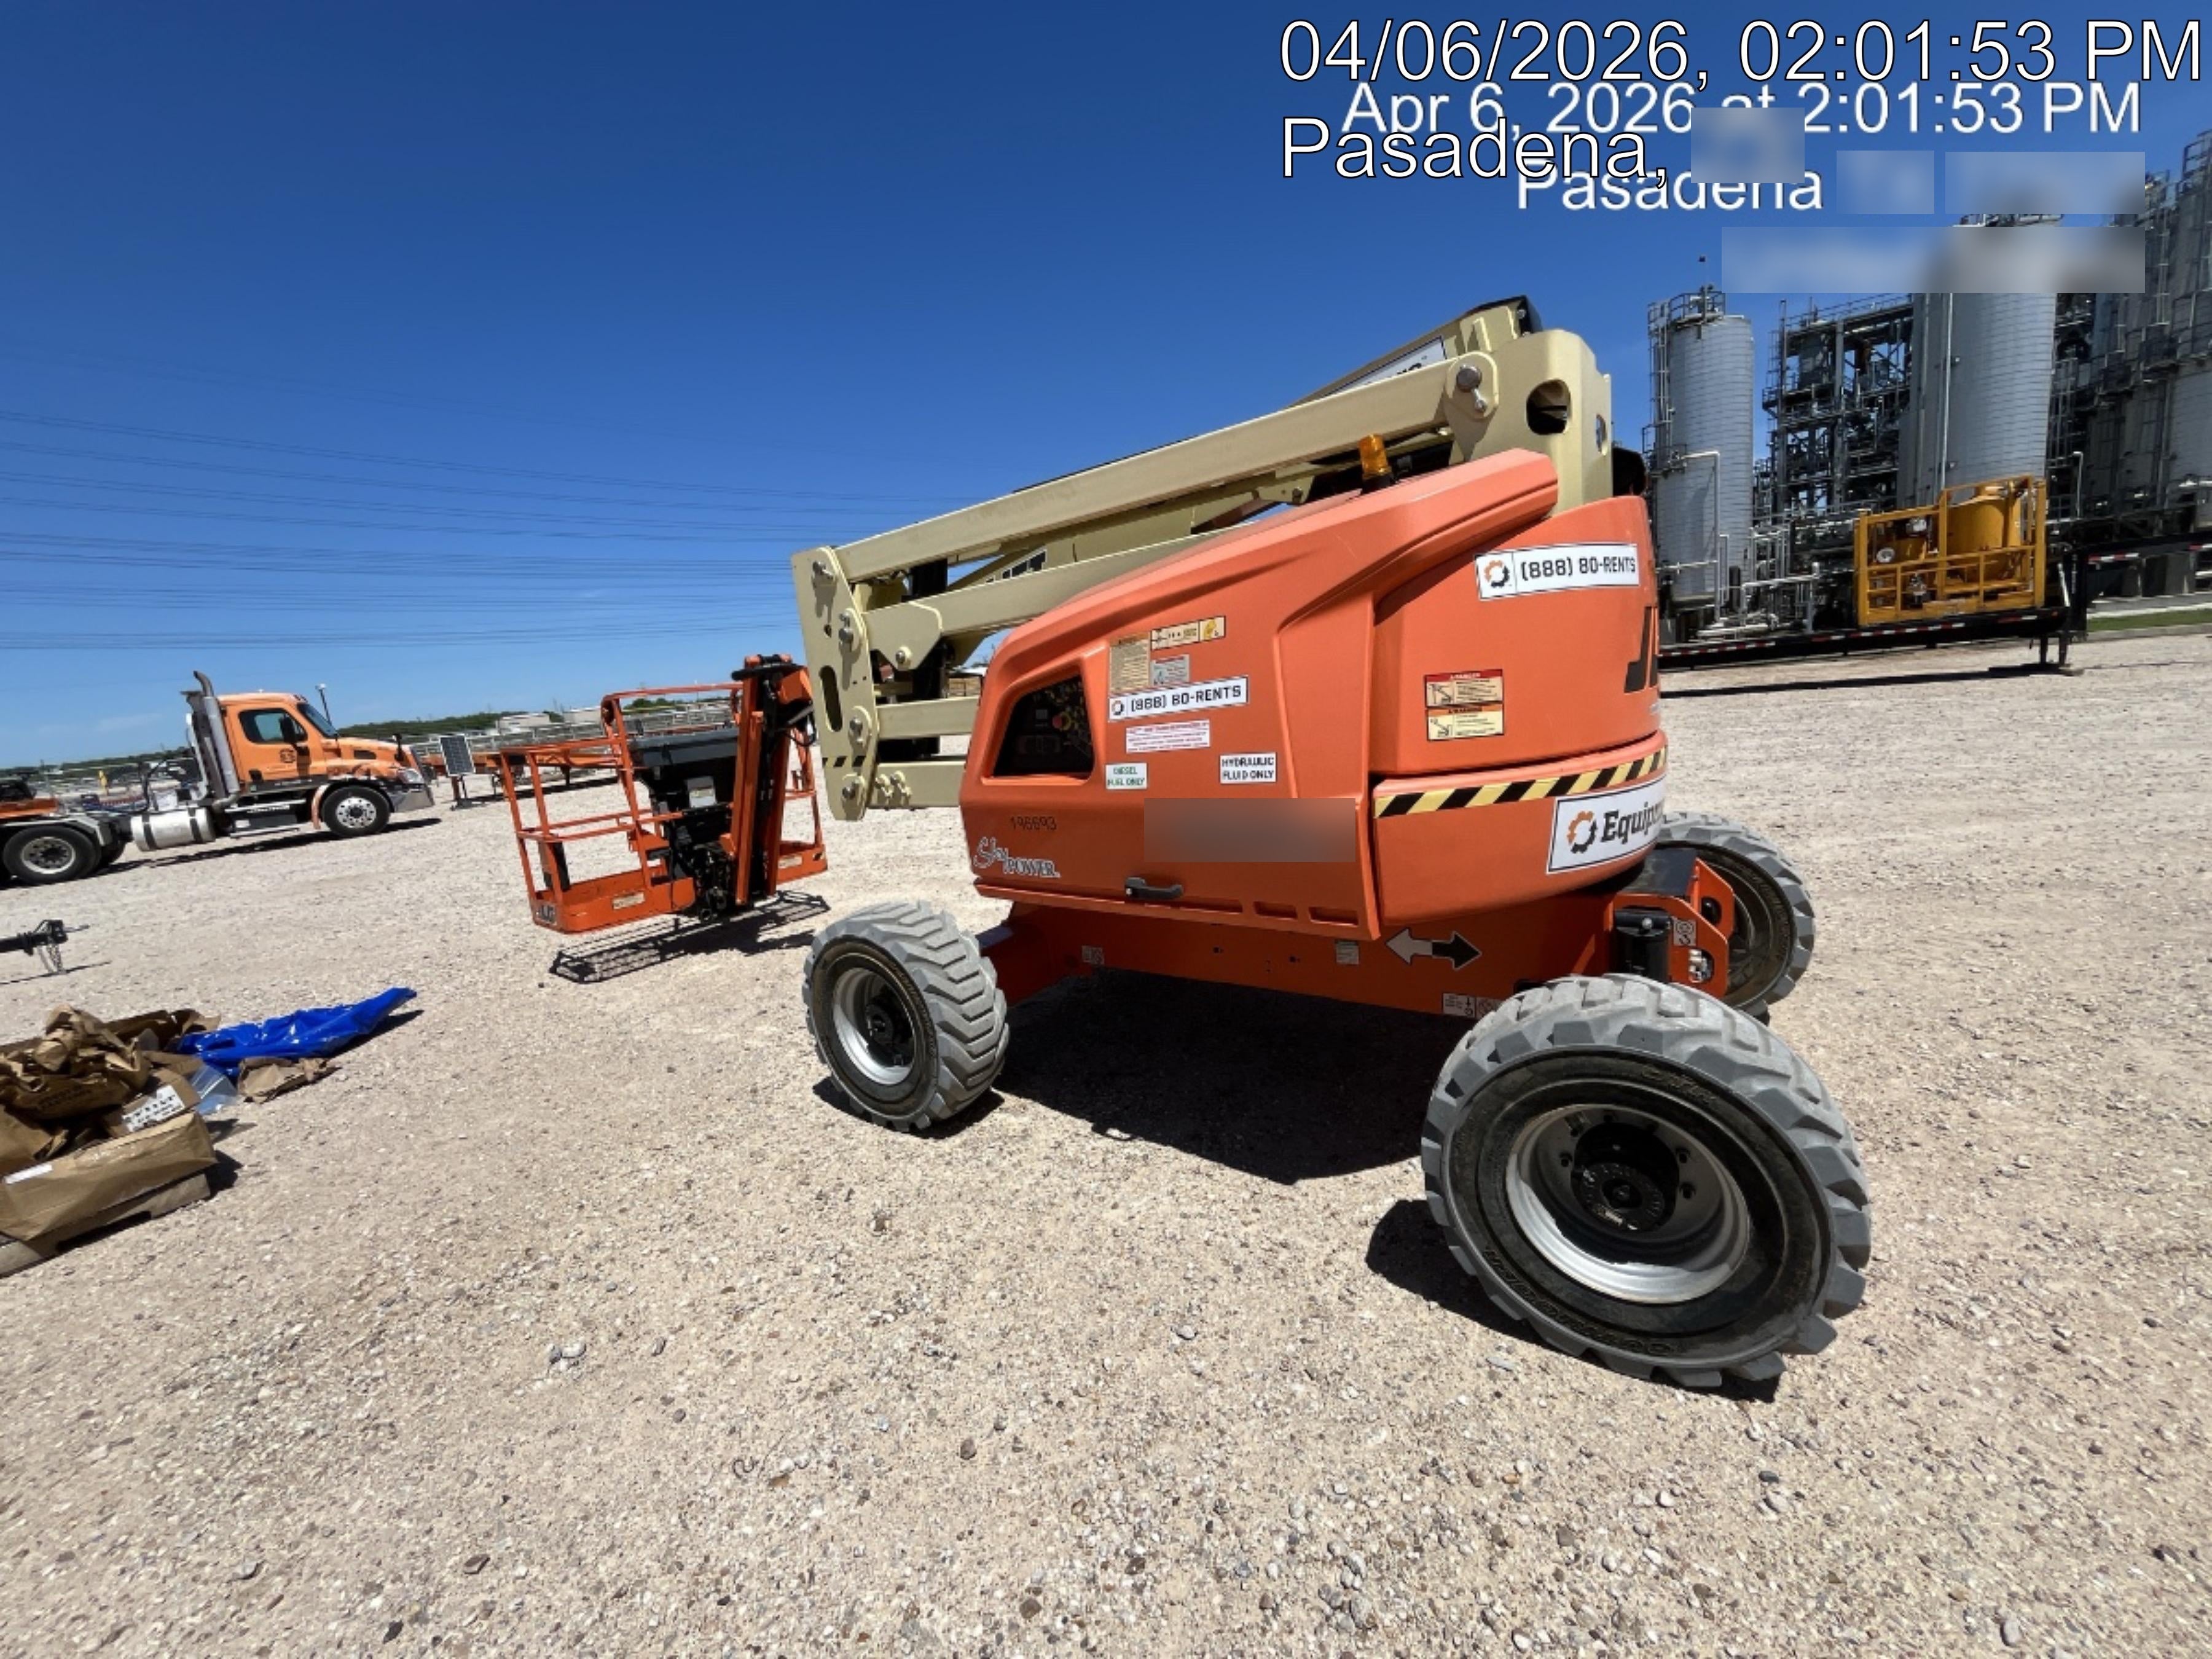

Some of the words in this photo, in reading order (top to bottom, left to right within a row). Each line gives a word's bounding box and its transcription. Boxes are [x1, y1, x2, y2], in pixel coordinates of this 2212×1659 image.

[1521, 557, 1573, 581] (888)
[1579, 556, 1636, 575] 80-RENTS
[1172, 685, 1241, 705] 80-RENTS
[1126, 777, 1145, 786] ONLY
[1250, 769, 1274, 779] ONLY
